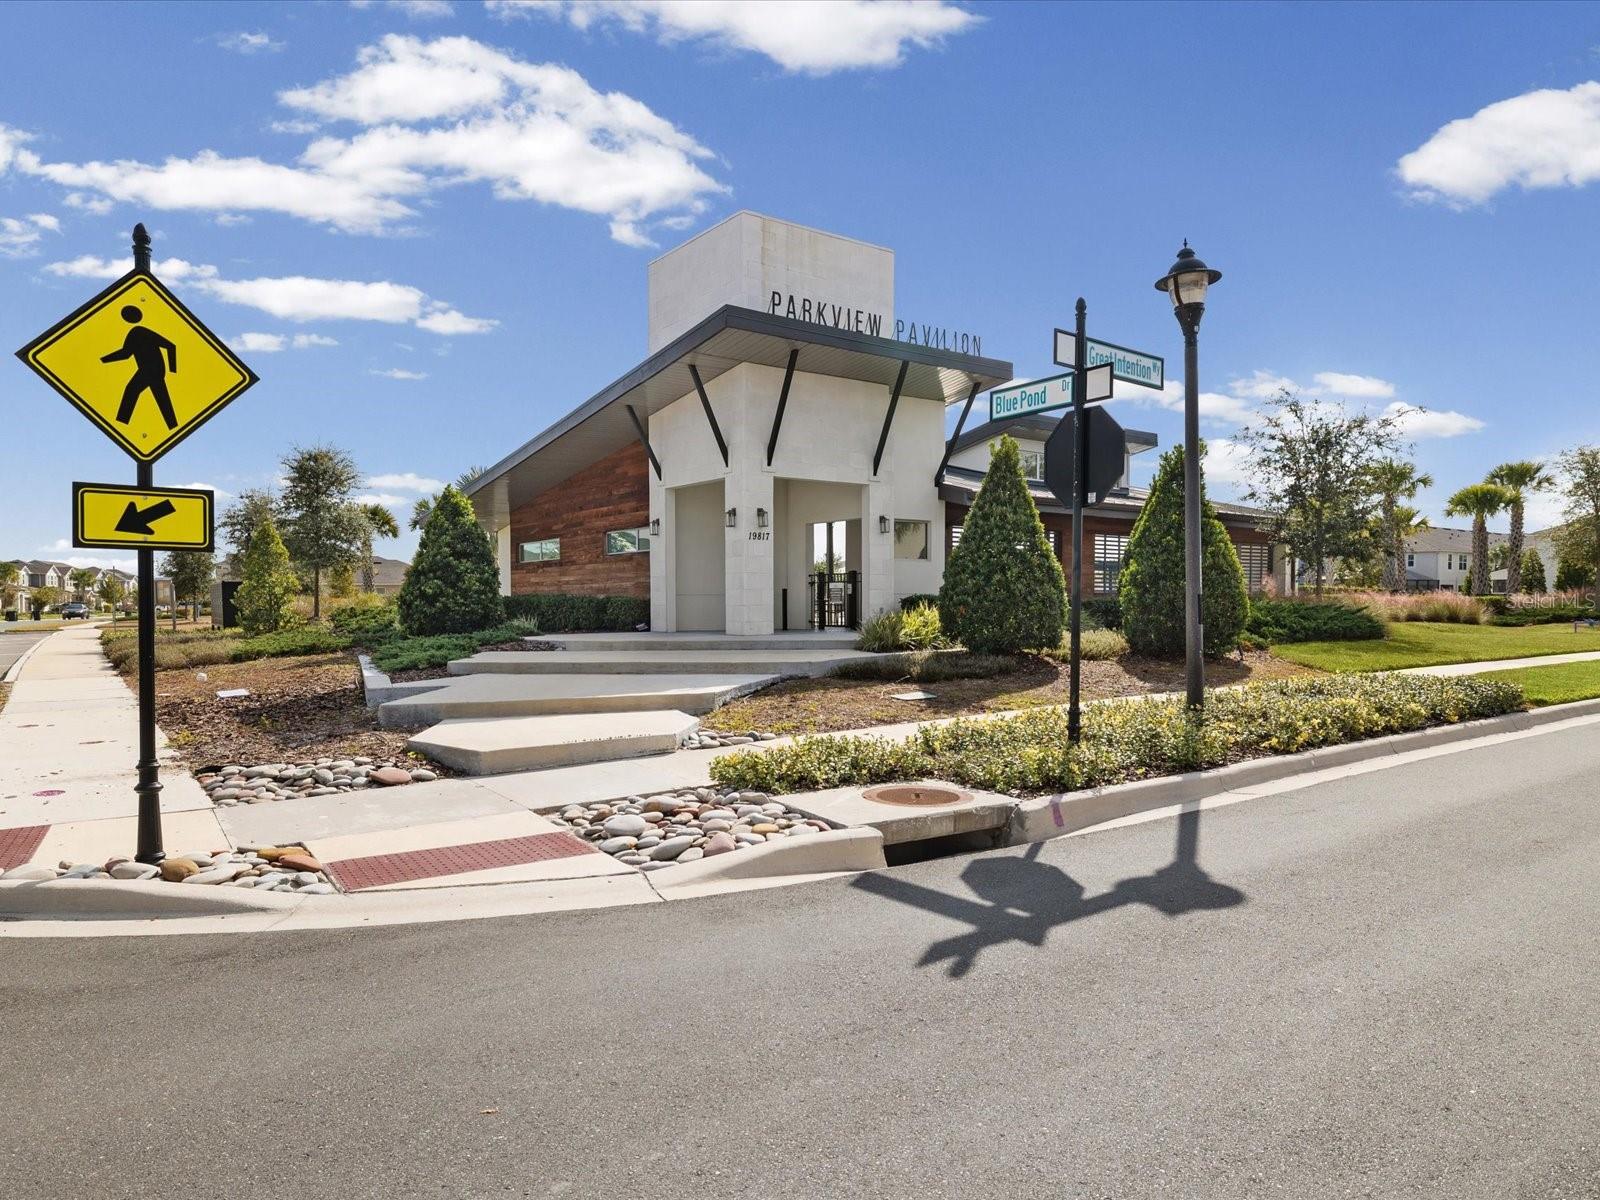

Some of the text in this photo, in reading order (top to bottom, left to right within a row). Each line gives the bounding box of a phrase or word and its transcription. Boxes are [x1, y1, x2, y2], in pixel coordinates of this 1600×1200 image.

[770, 291, 981, 357] PARKVIEW PAVILION
[1089, 346, 1161, 380] Great Intention Wy
[995, 380, 1071, 414] Blue Pond Dr
[749, 531, 770, 540] 19817
